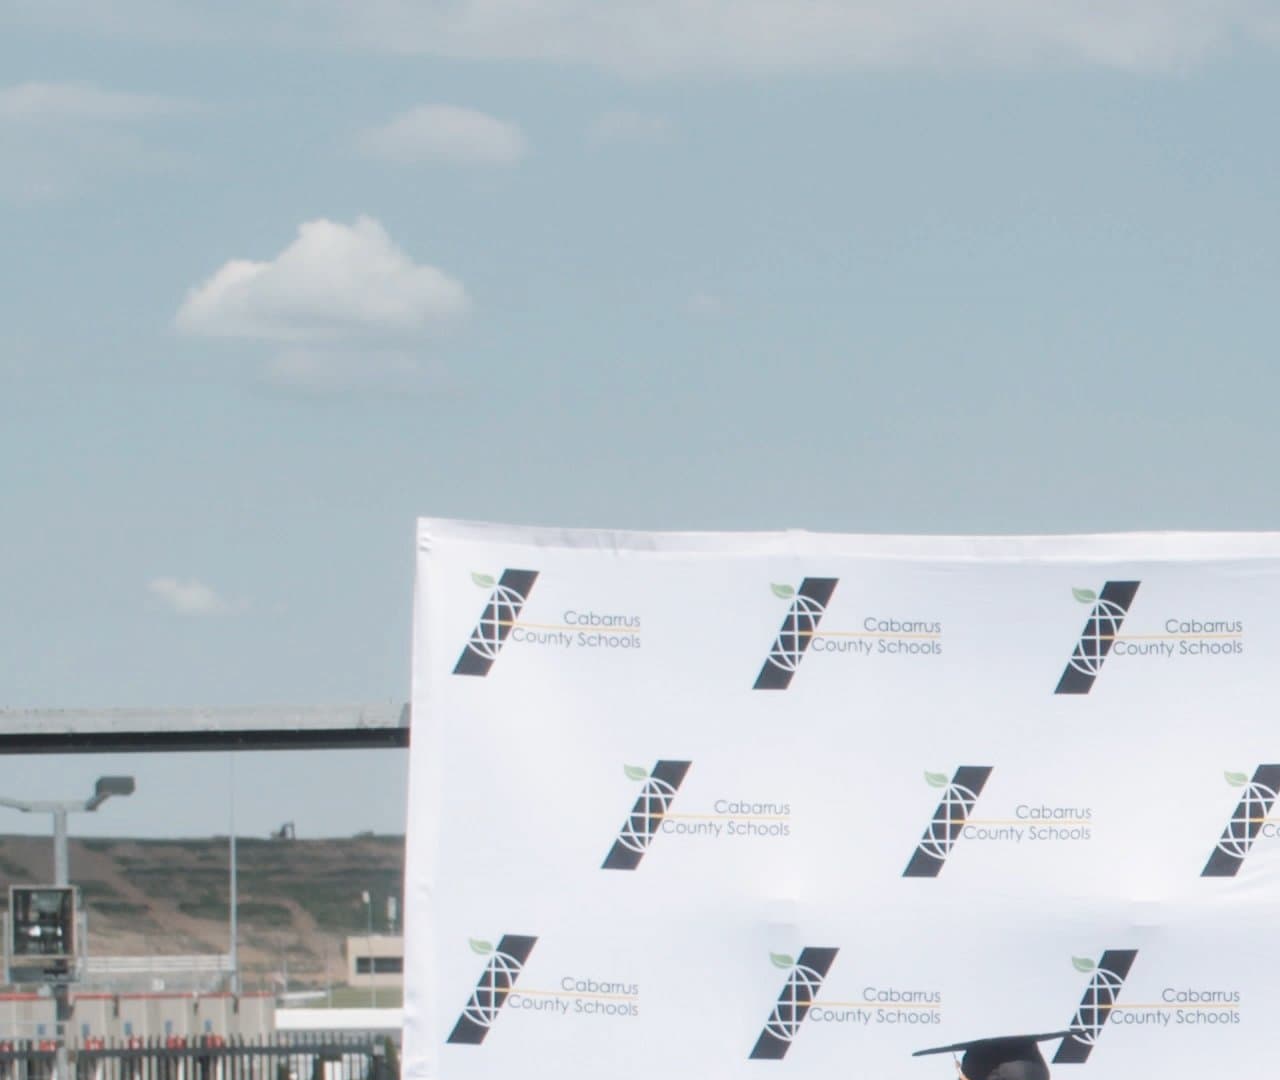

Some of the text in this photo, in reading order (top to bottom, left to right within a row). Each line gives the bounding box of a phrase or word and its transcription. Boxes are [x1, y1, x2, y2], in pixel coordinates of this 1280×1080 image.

[564, 611, 640, 626] Cabarrus
[864, 617, 940, 632] Cabarrus
[1166, 619, 1242, 633] Cabarrus
[511, 628, 640, 648] County Schools
[813, 634, 941, 654] County Schools
[1112, 638, 1242, 657] County Schools
[715, 801, 790, 814] Cabarrus
[1016, 805, 1091, 819] Cabarrus
[661, 816, 789, 836] County Schools
[963, 821, 1090, 840] County Schools
[562, 977, 638, 994] Cabarrus
[863, 987, 940, 1002] Cabarrus
[1162, 988, 1240, 1002] Cabarrus
[508, 995, 638, 1016] County Schools
[812, 1004, 940, 1024] County Schools
[1107, 1007, 1240, 1026] County Schools
